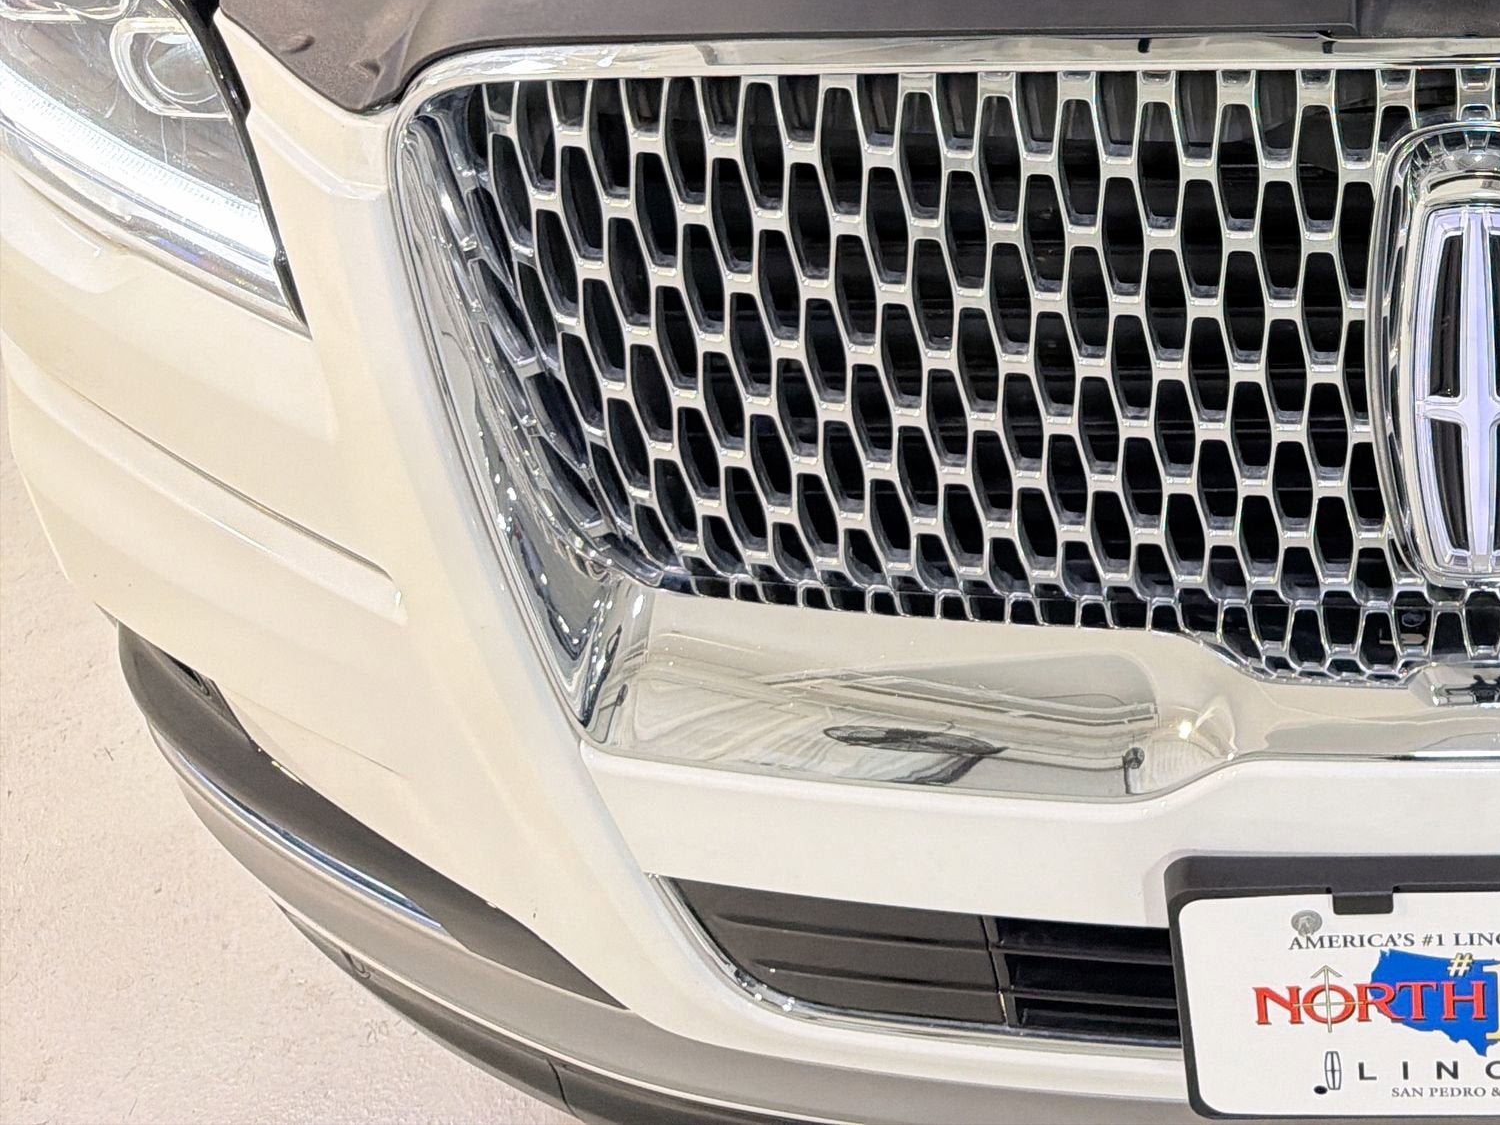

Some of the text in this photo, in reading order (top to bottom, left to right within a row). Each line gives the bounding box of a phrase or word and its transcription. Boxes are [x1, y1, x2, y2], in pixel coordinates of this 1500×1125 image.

[1288, 932, 1416, 951] AMERICA'S
[1421, 932, 1445, 947] #1
[1252, 979, 1487, 1026] NORTH
[1391, 1086, 1424, 1098] SAN
[1429, 1086, 1486, 1098] PEDRO
